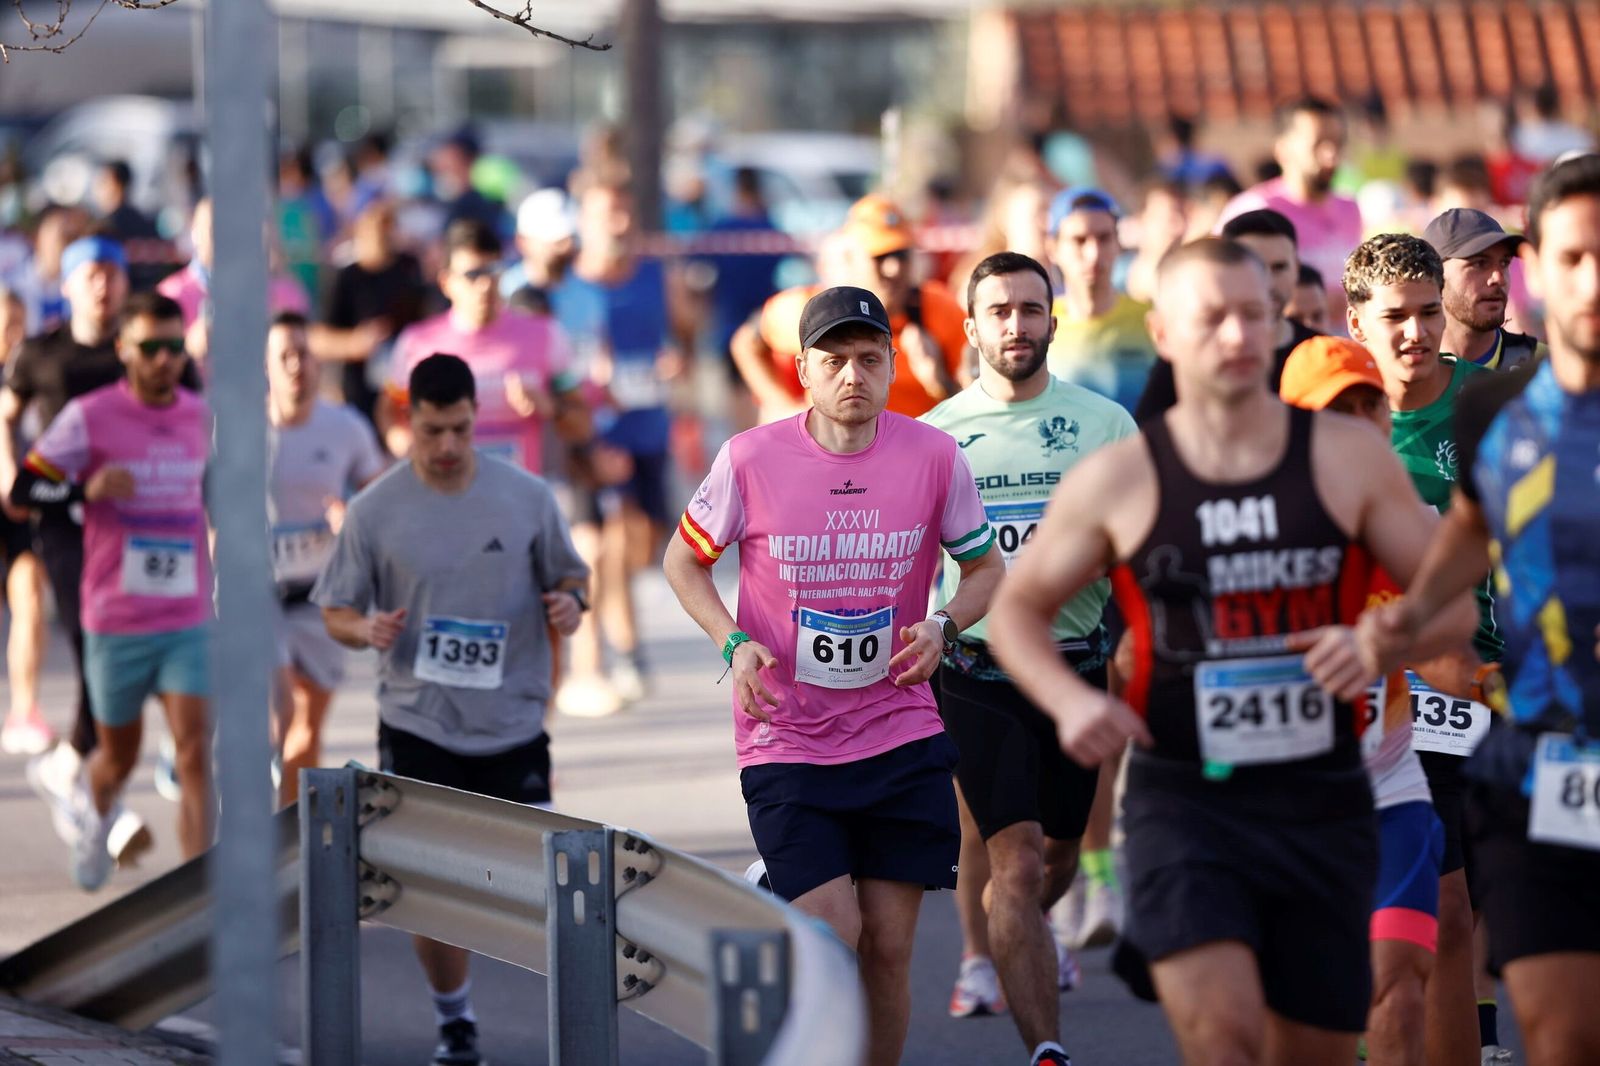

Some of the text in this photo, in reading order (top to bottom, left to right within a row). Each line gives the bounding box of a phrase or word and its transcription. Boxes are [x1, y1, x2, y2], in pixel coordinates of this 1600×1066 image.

[829, 487, 868, 496] TEAMERGY
[825, 509, 880, 530] XXXVI
[1195, 494, 1280, 546] 1041
[768, 534, 830, 561] MEDIA
[779, 563, 886, 583] INTERNACIONAL
[1206, 546, 1342, 593] MIKES
[800, 586, 857, 600] INTERNATIONAL
[858, 585, 877, 598] HALF
[1215, 584, 1333, 639] GYM
[427, 634, 499, 667] 1393
[813, 635, 879, 665] 610
[1209, 682, 1324, 728] 2416
